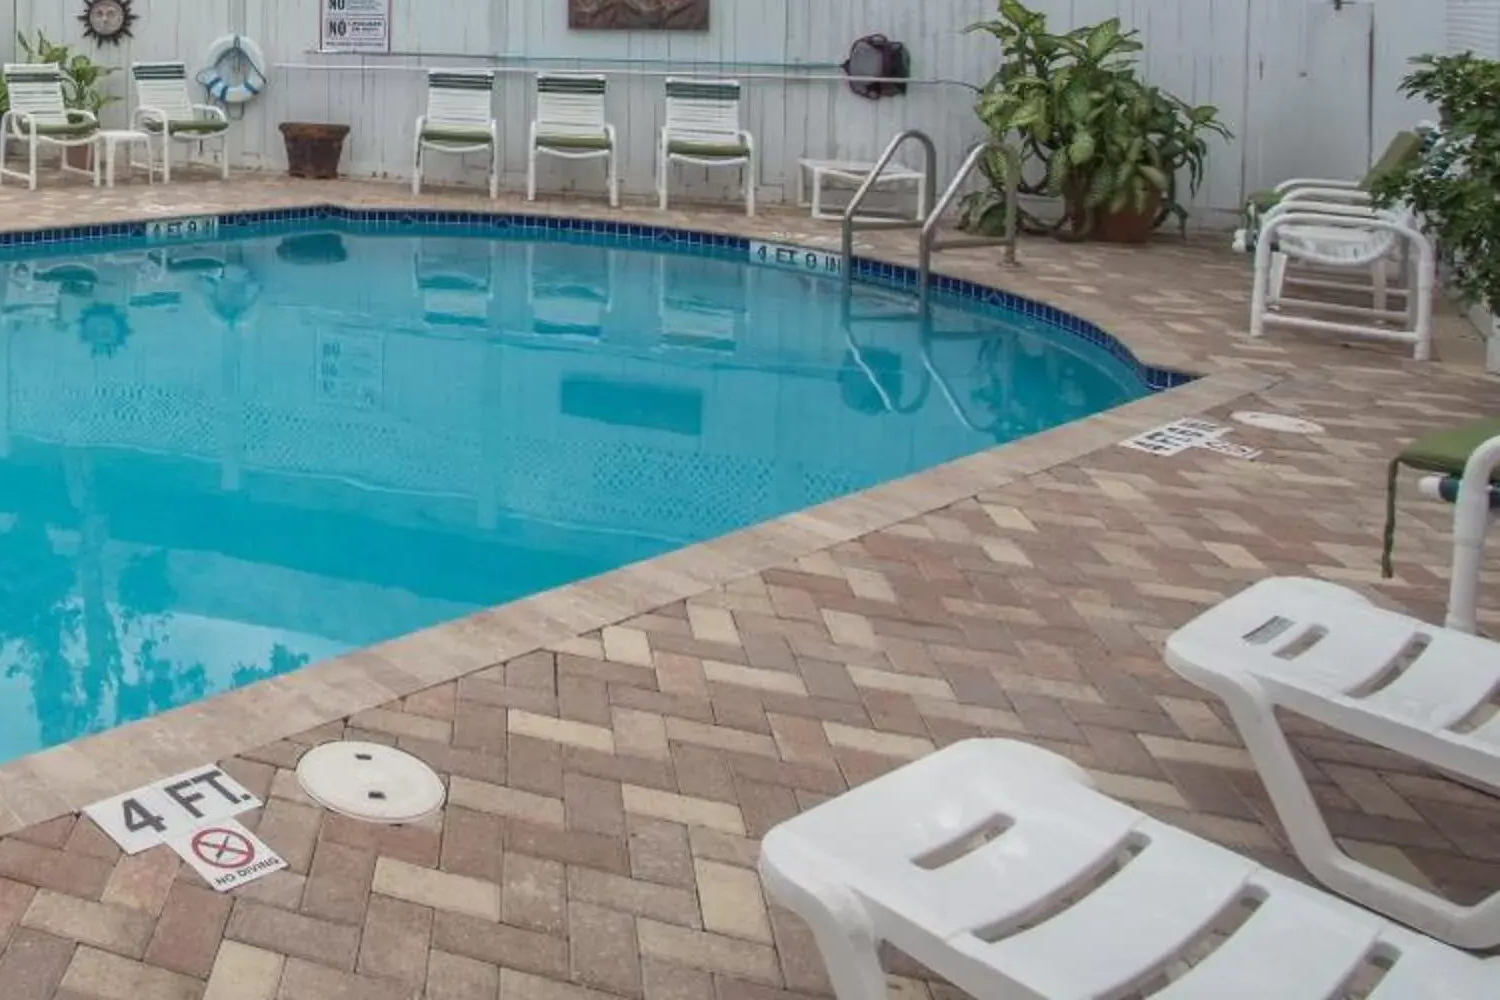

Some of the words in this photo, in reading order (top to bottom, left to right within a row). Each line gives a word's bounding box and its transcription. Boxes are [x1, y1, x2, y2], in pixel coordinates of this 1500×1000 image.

[329, 20, 347, 37] NO
[121, 797, 167, 833] 4
[214, 873, 236, 885] NO
[235, 856, 279, 877] DIVING
